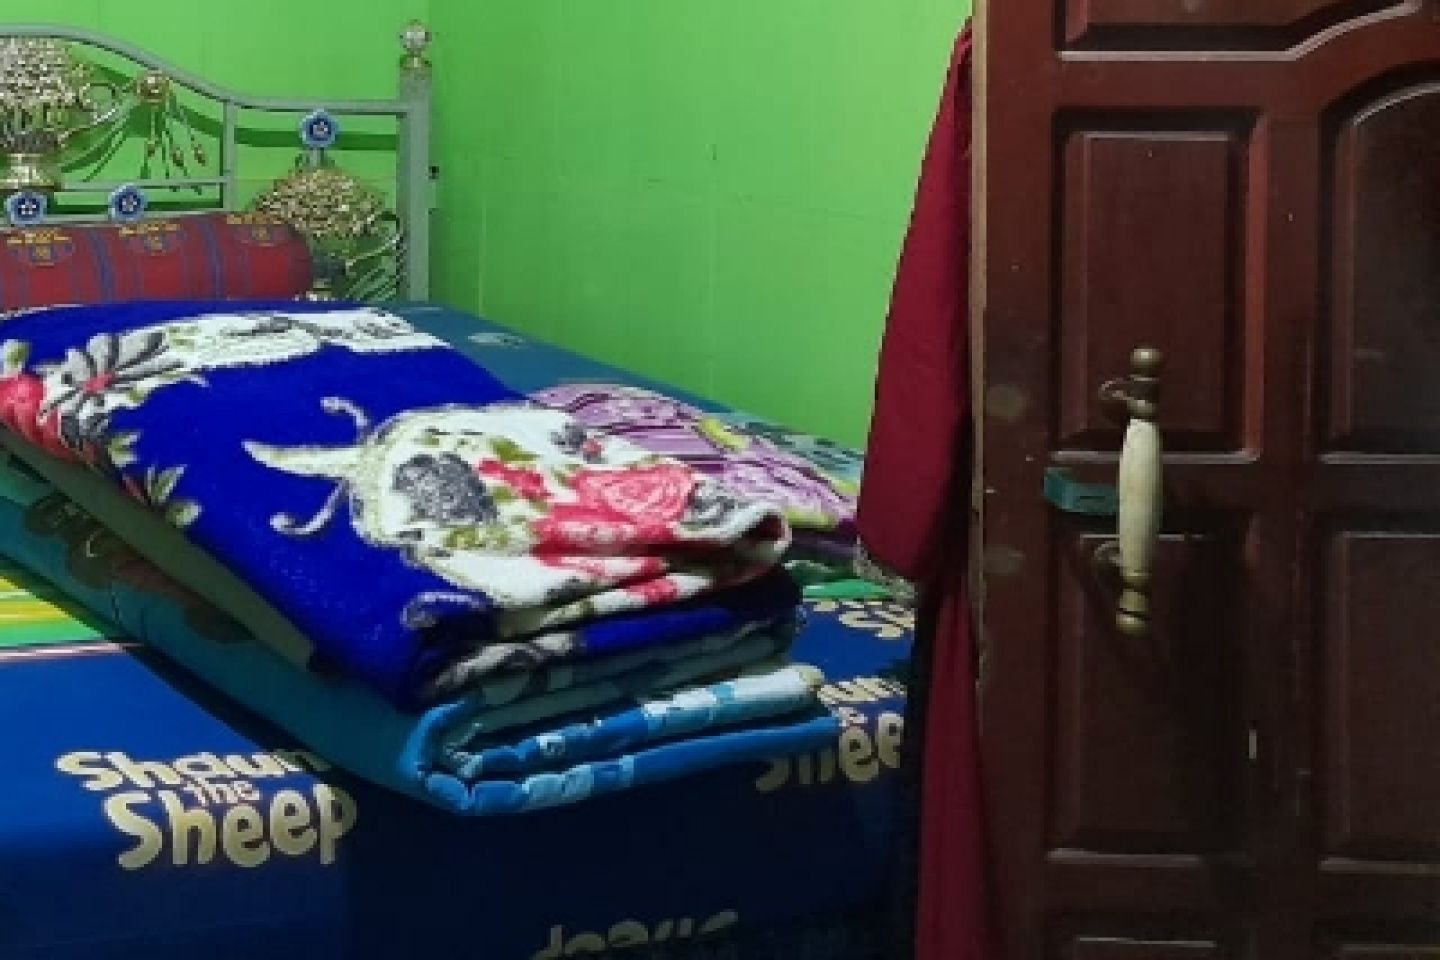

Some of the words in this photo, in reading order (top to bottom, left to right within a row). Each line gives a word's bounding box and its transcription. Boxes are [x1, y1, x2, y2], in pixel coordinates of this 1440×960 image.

[54, 751, 334, 791] Shaun
[183, 778, 261, 807] the
[103, 783, 358, 870] Sheep
